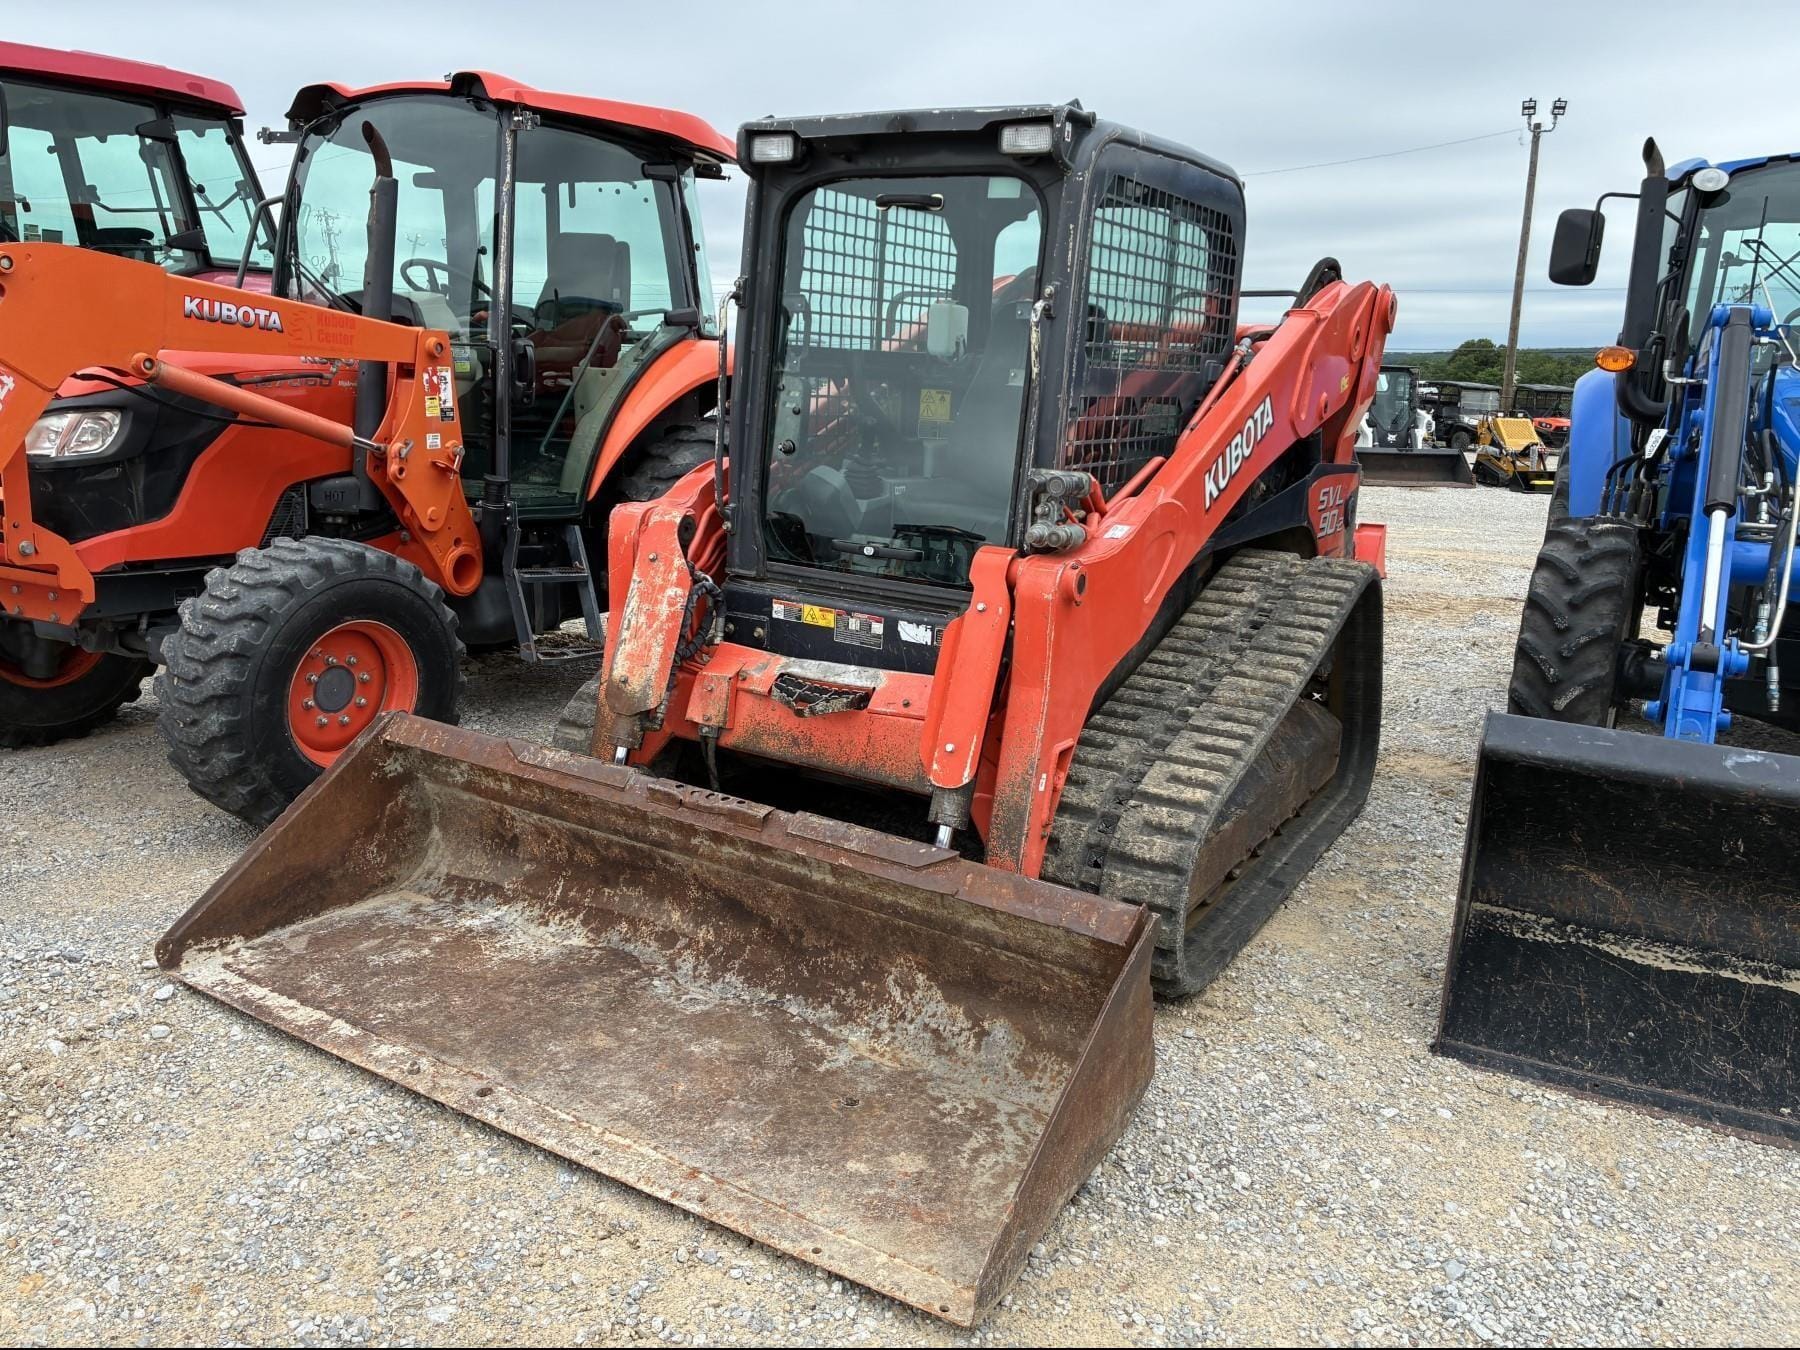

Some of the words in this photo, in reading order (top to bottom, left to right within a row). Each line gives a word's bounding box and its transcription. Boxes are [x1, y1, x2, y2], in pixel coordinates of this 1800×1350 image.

[184, 295, 284, 333] KUBOTA
[1204, 393, 1274, 513] KUBOTA
[324, 490, 345, 502] HOT
[1317, 484, 1344, 512] SVL
